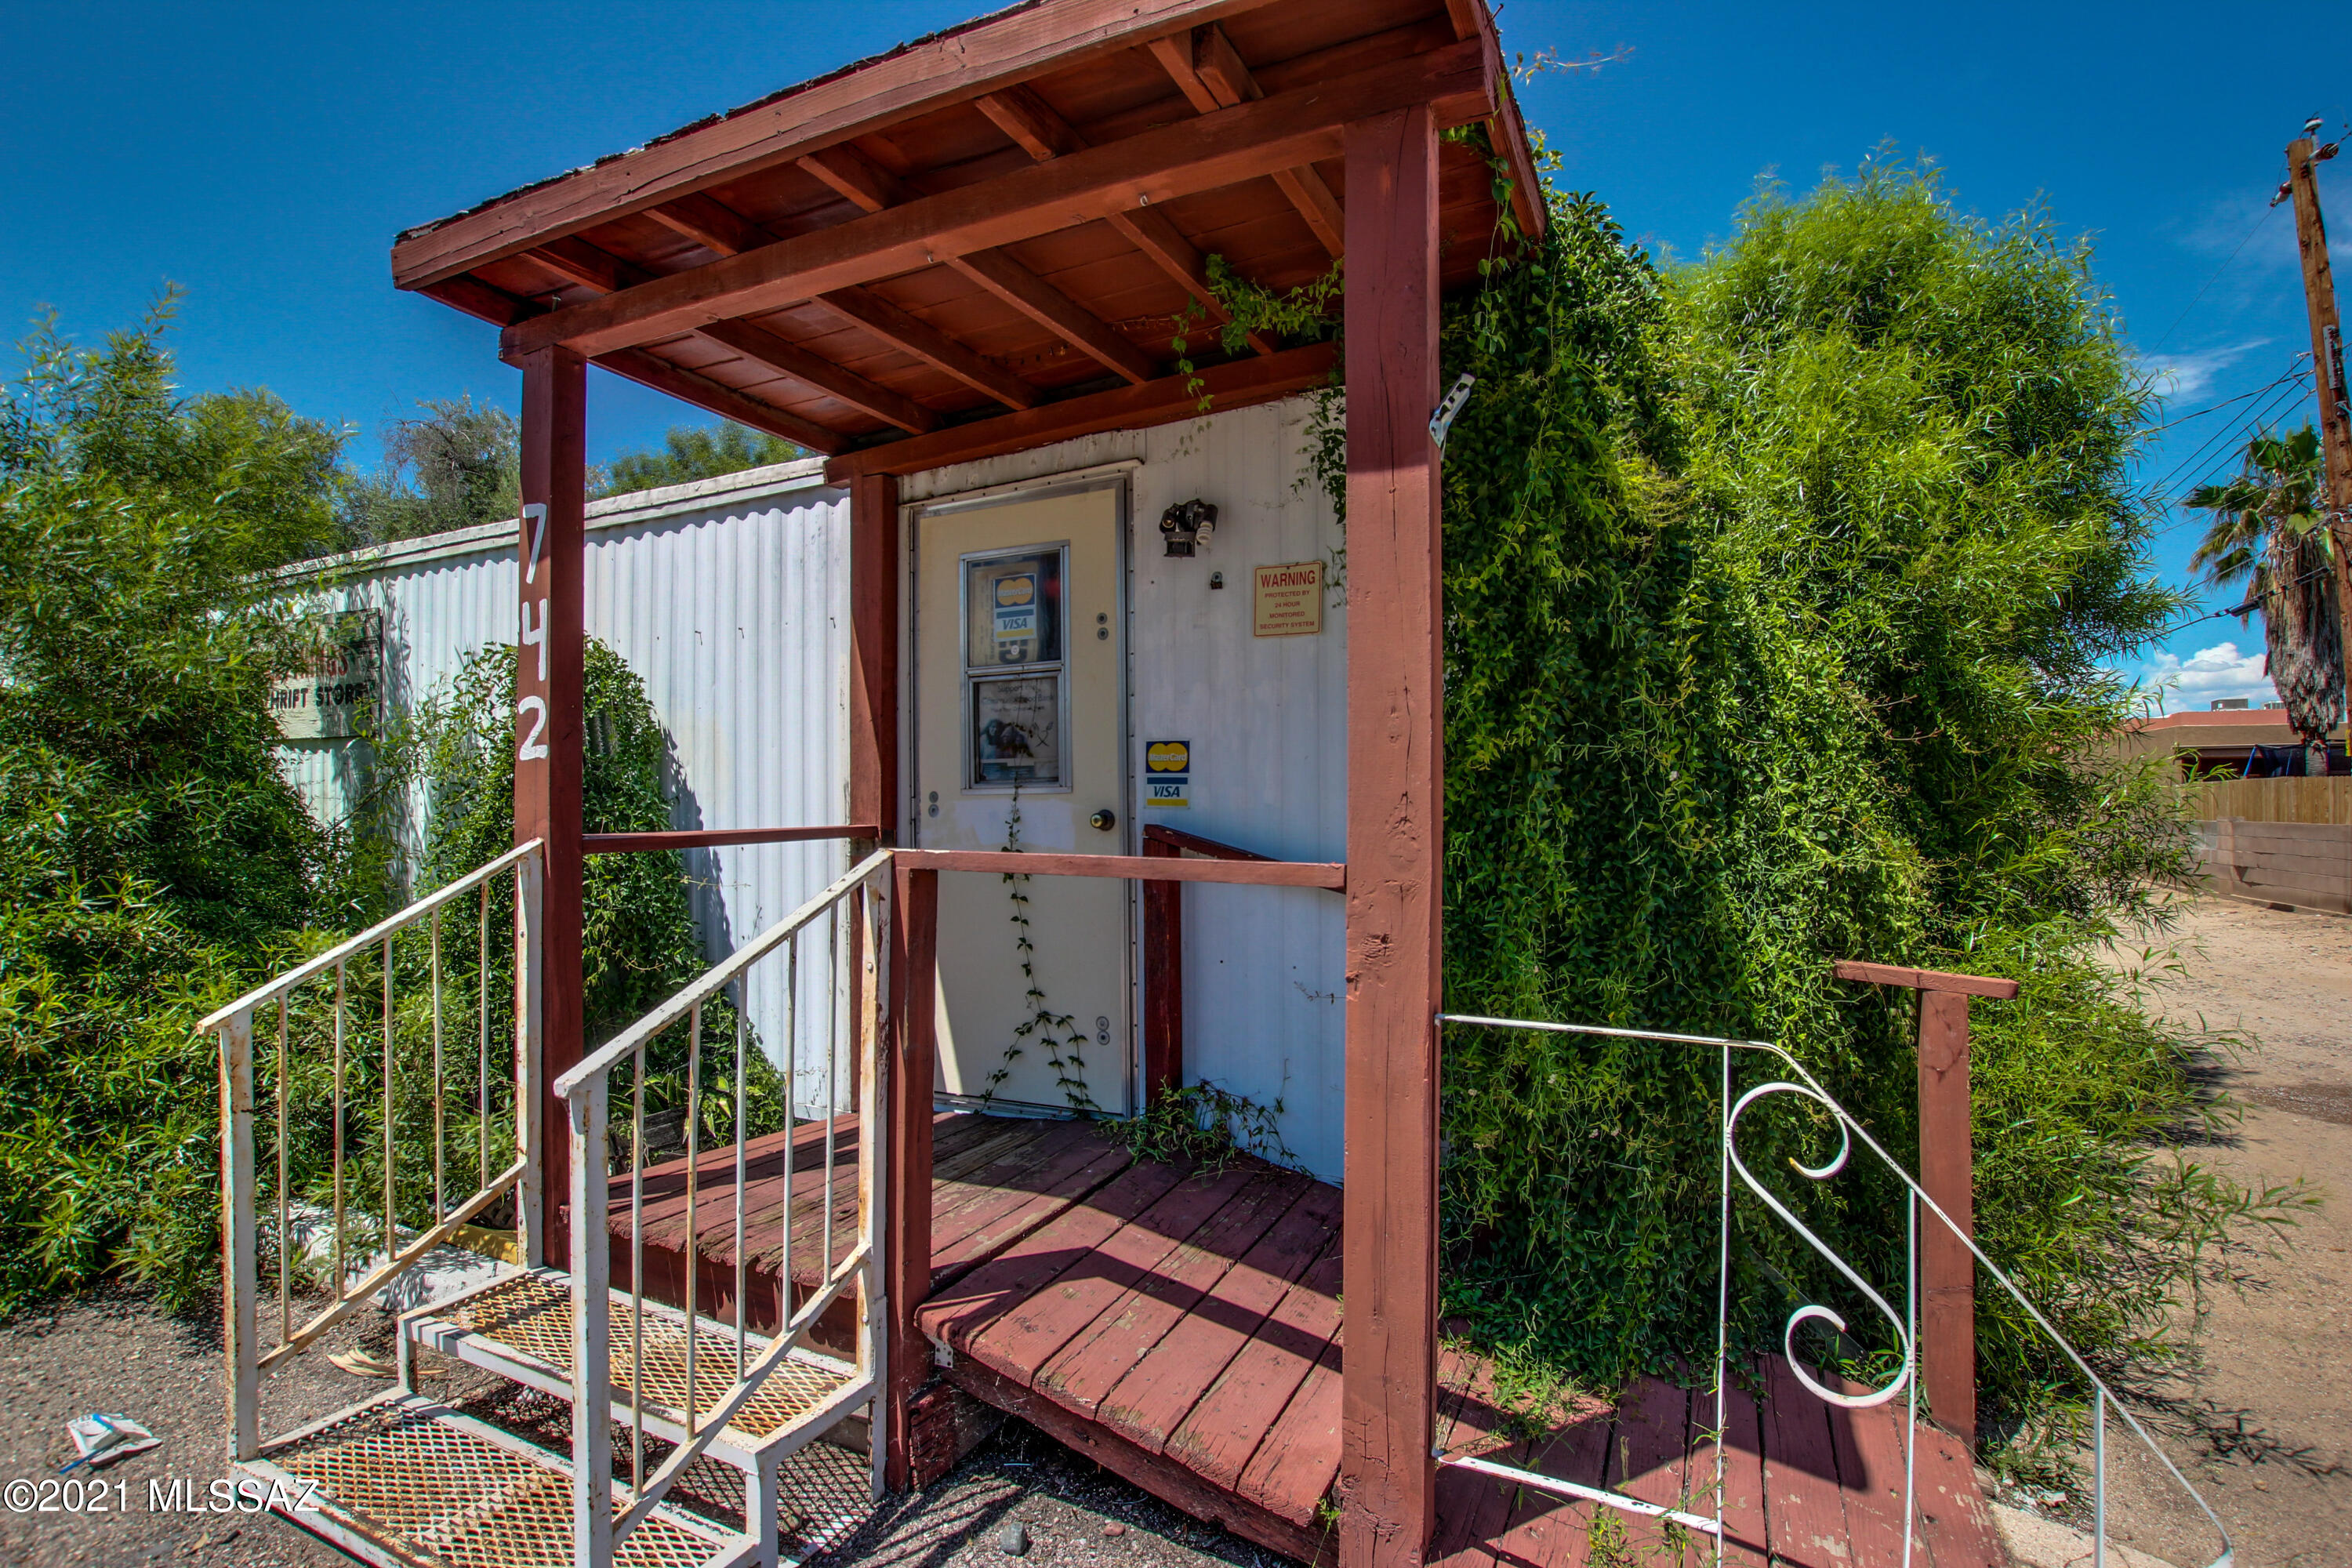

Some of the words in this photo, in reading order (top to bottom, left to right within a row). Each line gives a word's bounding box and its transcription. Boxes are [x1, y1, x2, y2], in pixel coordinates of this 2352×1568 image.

[1261, 570, 1316, 589] WARNING
[517, 503, 549, 761] 742
[1002, 617, 1028, 630] VISA
[267, 688, 309, 710] HRIFT
[1154, 786, 1181, 798] VISA
